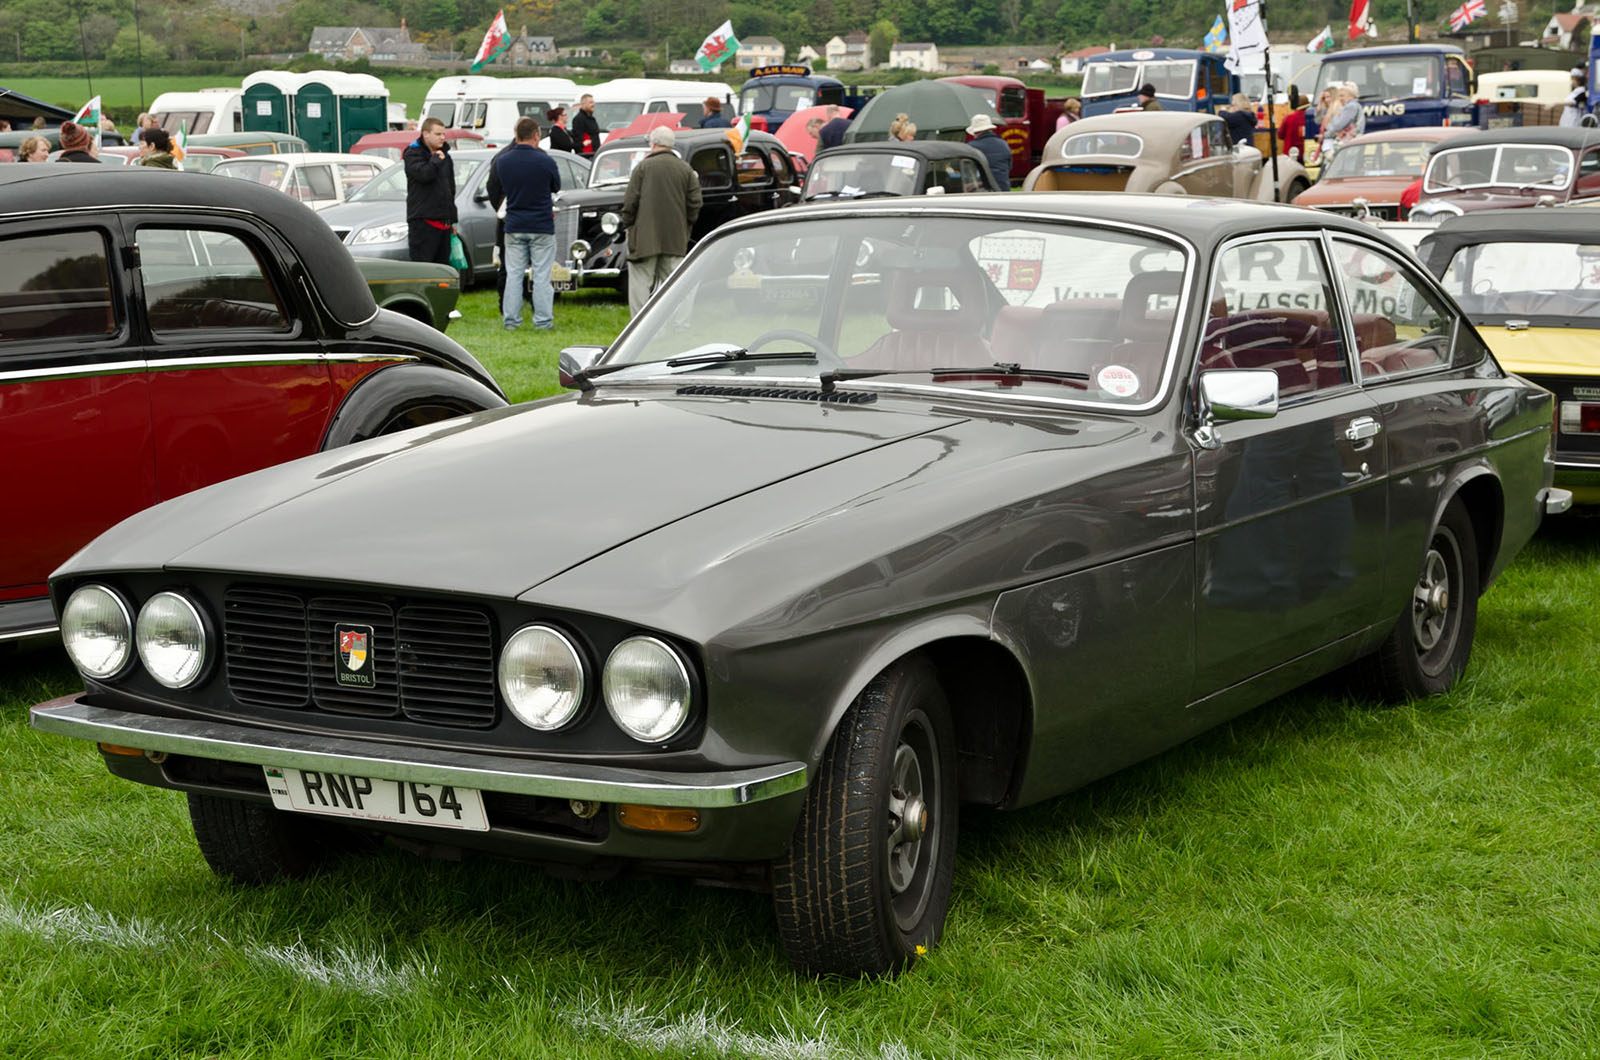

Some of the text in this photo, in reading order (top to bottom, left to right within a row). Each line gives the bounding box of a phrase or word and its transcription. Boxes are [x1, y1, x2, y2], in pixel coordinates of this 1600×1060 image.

[340, 673, 370, 684] BRISTOL
[299, 769, 463, 820] RNP 764
